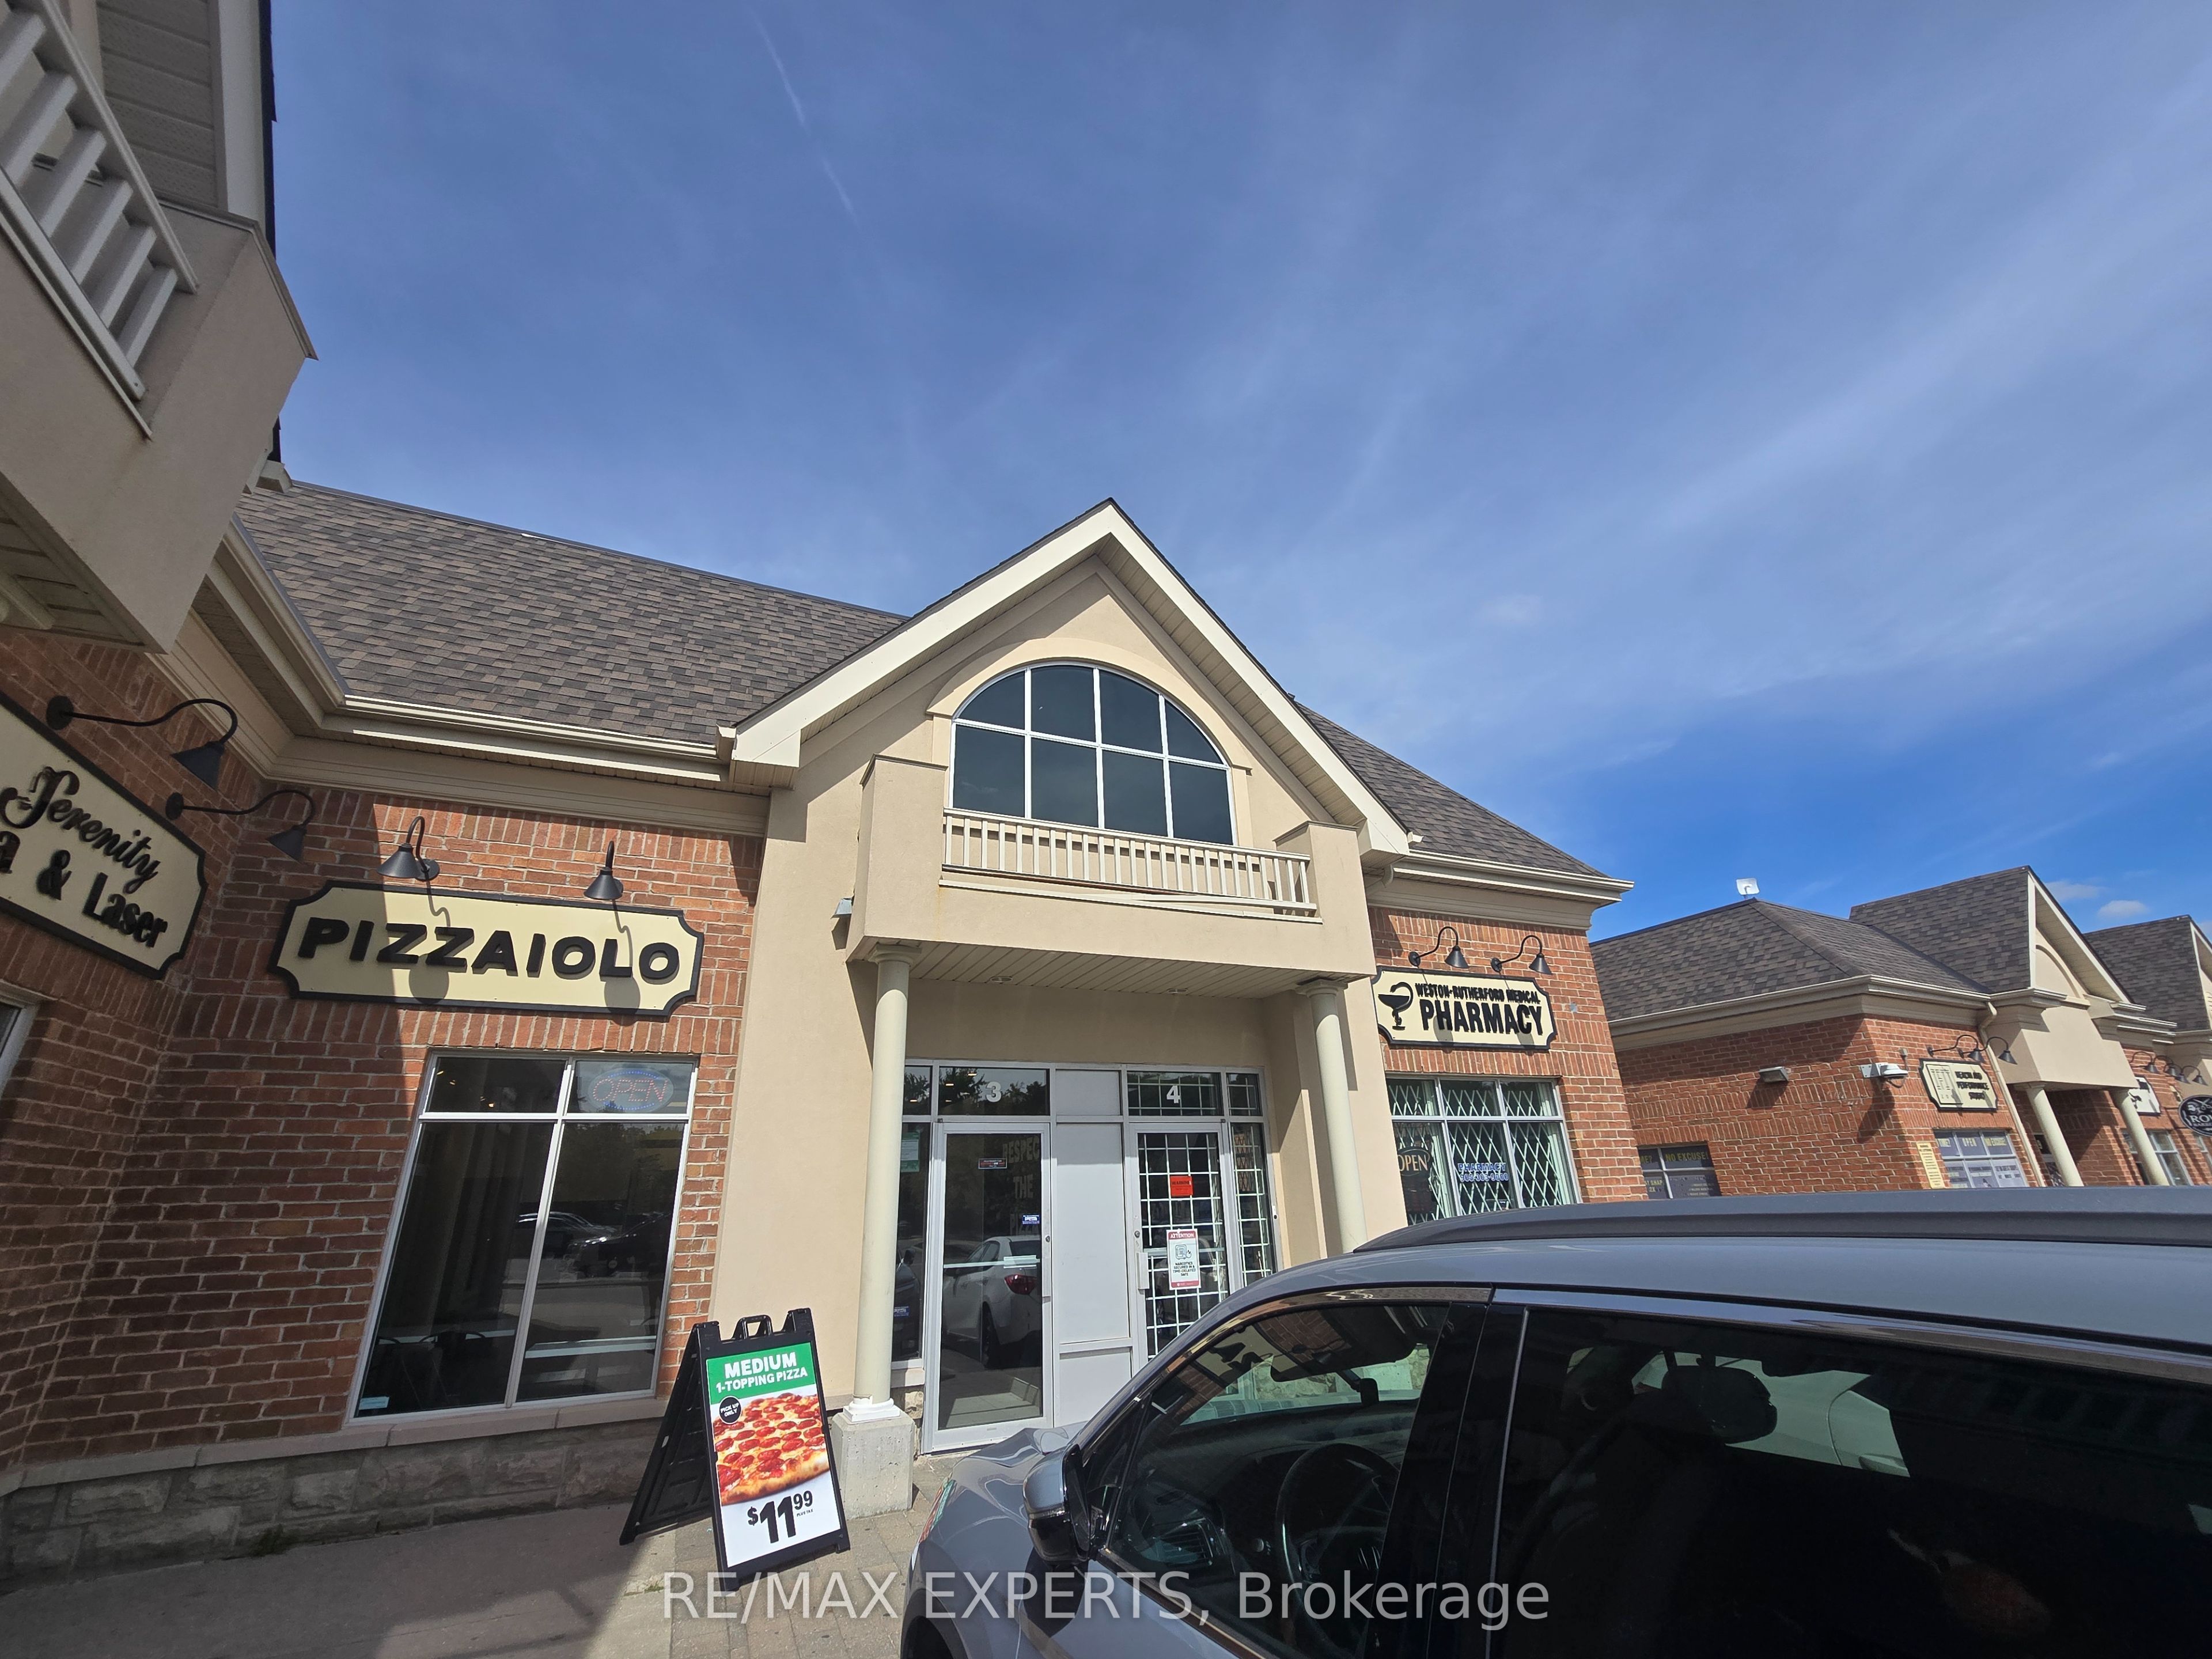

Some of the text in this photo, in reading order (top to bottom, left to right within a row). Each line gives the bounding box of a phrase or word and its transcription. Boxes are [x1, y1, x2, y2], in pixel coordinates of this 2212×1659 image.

[1, 766, 161, 894] Serenity
[36, 849, 73, 901] &
[82, 872, 168, 948] Laser
[298, 917, 680, 980] PIZZAIOLO
[1415, 983, 1541, 1004] WESTON-RUTHERFORD MEDICAL
[1419, 999, 1543, 1035] PHARMACY
[593, 1077, 669, 1103] OPEN
[986, 1081, 1002, 1103] 3
[1166, 1085, 1180, 1104] 4
[2188, 1114, 2212, 1123] RO
[1397, 1154, 1429, 1172] OPEN
[1457, 1162, 1506, 1172] PHARMACY
[1665, 1153, 1676, 1161] NO
[1677, 1152, 1709, 1162] EXCUSE!
[1013, 1174, 1034, 1199] THE
[724, 1351, 797, 1379] MEDIUM
[716, 1366, 808, 1393] 1-TOPPING PIZZA
[724, 1409, 738, 1417] ONLY
